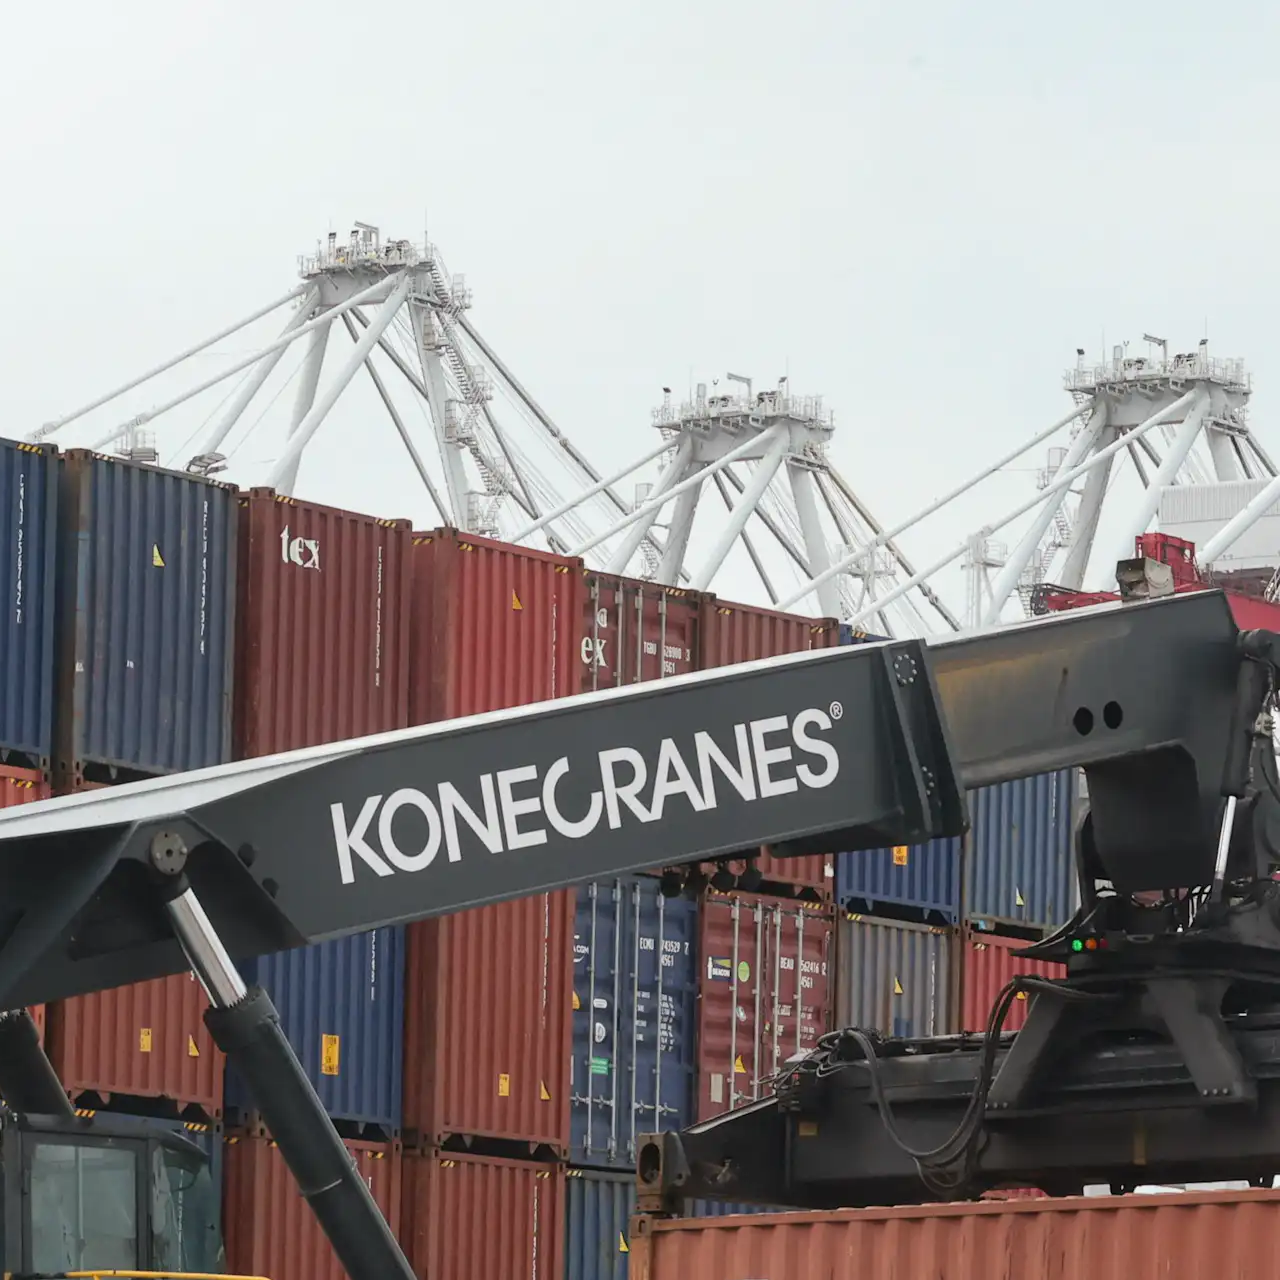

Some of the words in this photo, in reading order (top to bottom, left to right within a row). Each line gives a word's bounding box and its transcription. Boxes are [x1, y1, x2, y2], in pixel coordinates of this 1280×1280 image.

[280, 524, 321, 571] tex
[780, 957, 794, 970] BEAU
[713, 968, 730, 977] BEACON
